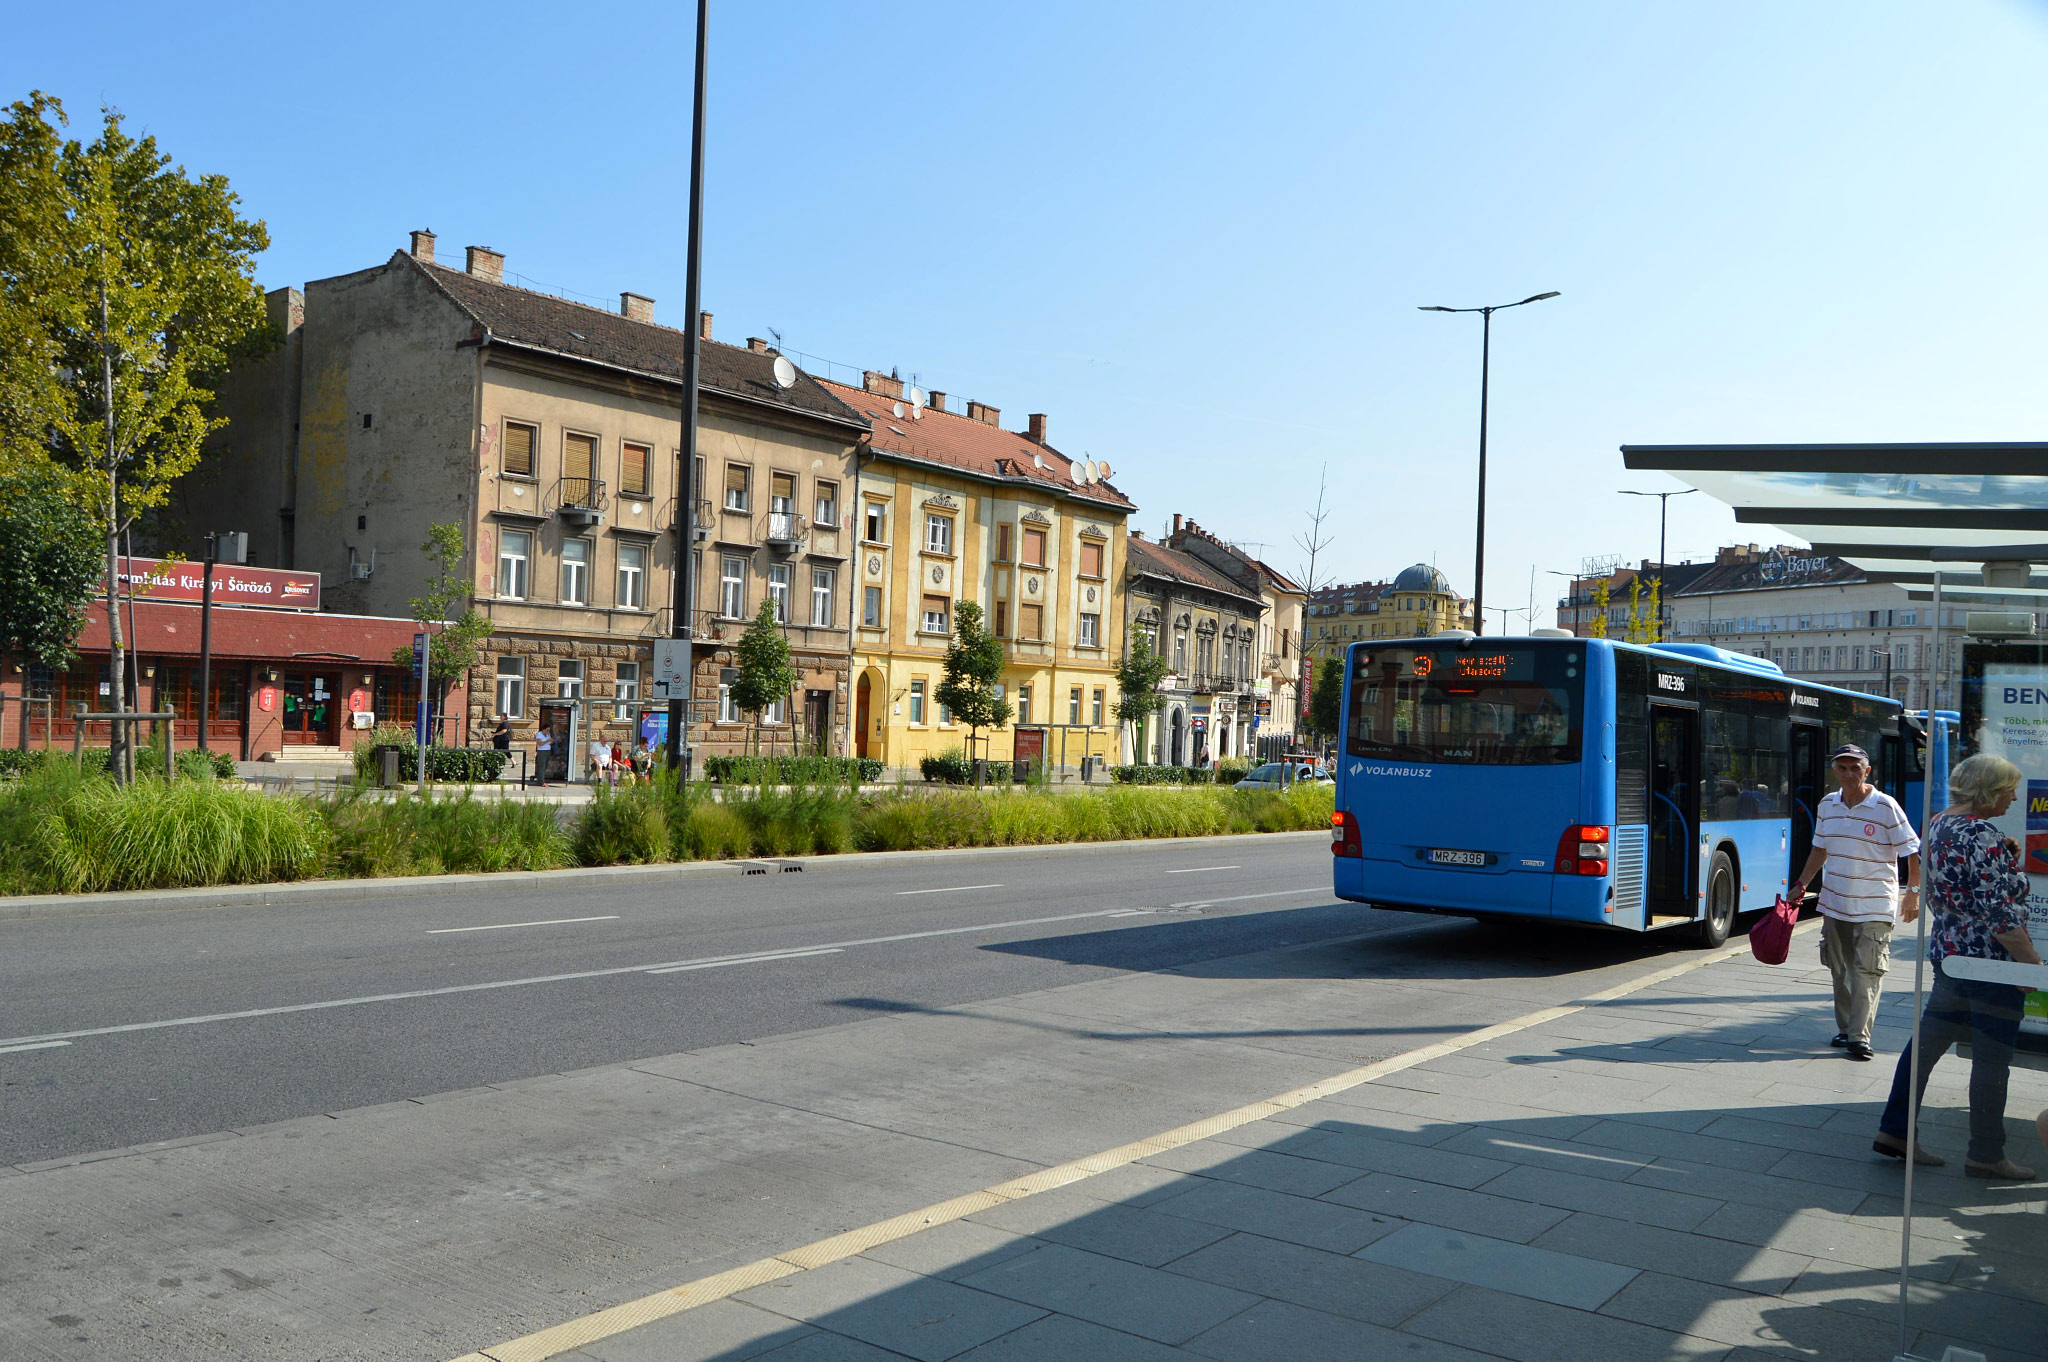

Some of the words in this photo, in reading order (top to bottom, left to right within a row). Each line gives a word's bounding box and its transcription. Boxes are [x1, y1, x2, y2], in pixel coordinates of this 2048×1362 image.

[1787, 556, 1829, 576] Bayer
[117, 572, 176, 587] rombitás
[180, 575, 223, 593] Kiráyi
[228, 576, 272, 594] Šöröző
[1658, 673, 1685, 692] MRZ-396
[2003, 687, 2048, 705] BEN
[2003, 716, 2030, 726] Több,
[2002, 727, 2037, 736] Keresse
[1443, 749, 1473, 757] MAN
[1366, 766, 1432, 778] VOLÁNBUSZ
[1435, 851, 1482, 864] MRZ-396
